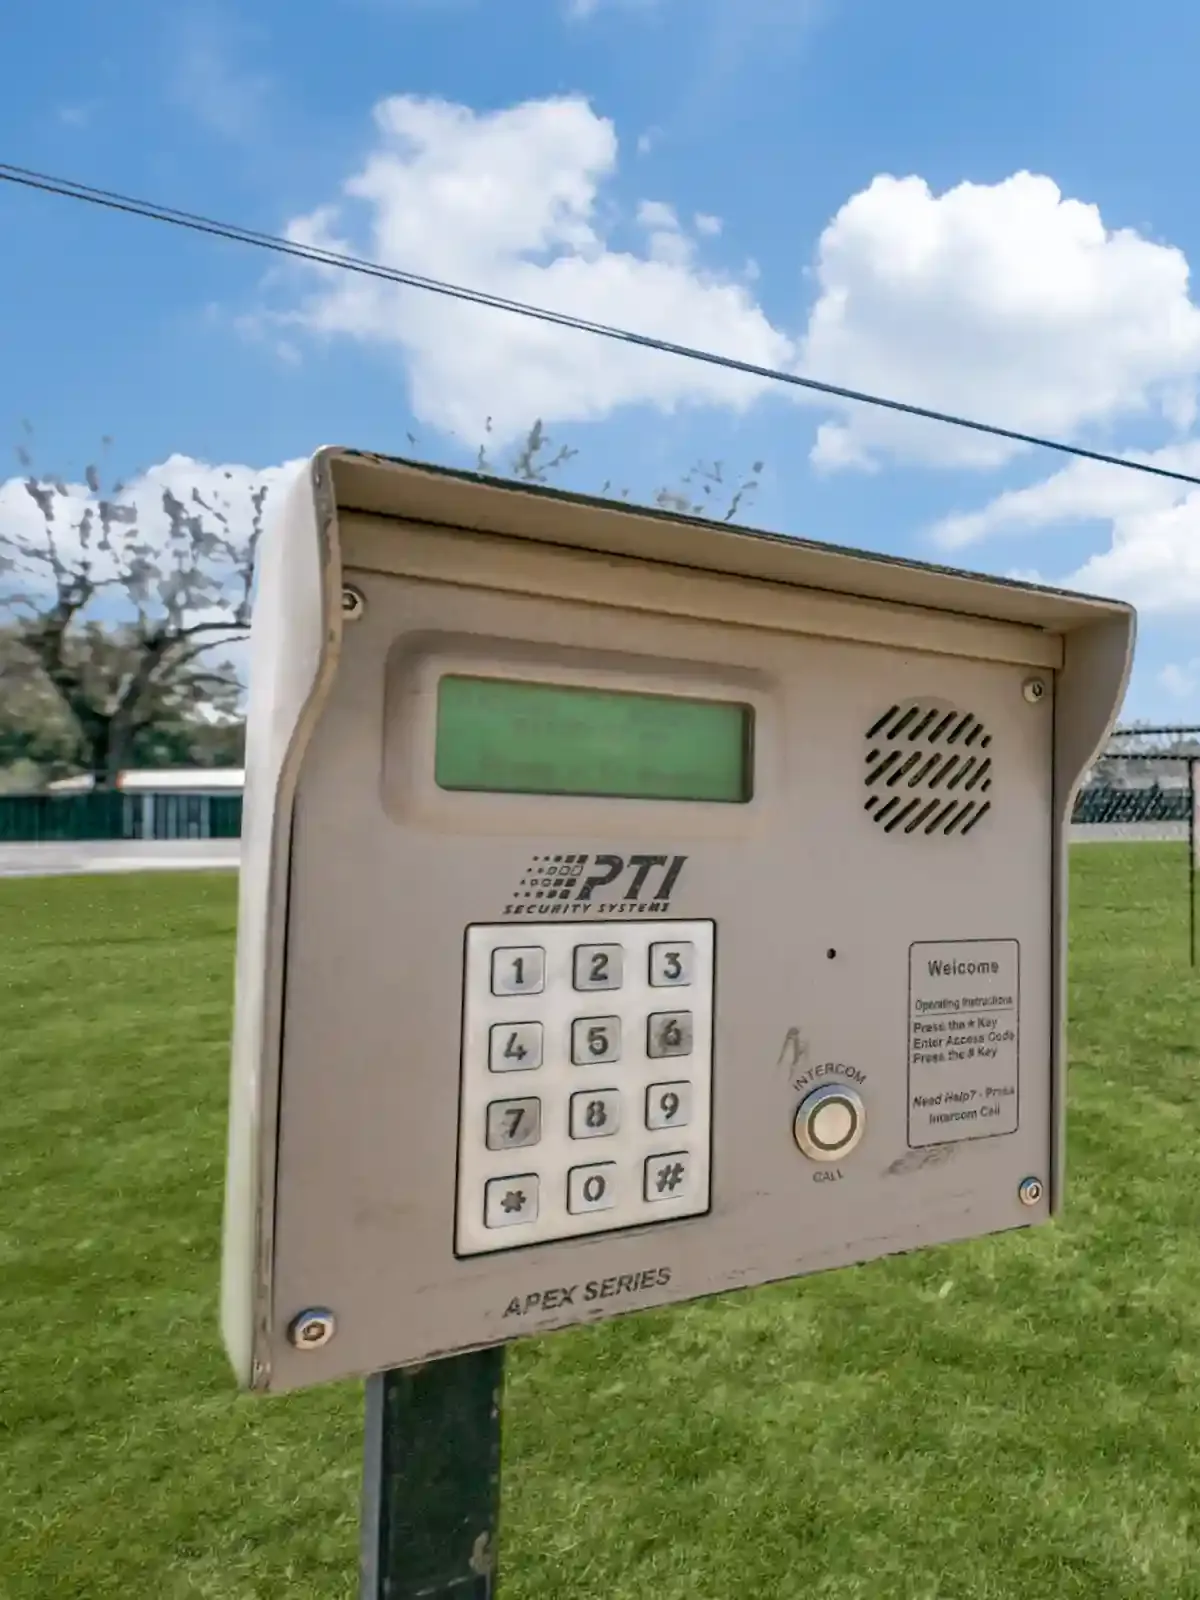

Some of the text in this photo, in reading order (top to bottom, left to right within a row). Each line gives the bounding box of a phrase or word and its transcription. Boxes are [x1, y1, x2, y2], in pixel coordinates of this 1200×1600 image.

[574, 854, 689, 900] PTI
[503, 902, 670, 915] SECURITY SYSTEMS
[512, 952, 682, 985] 1 2 3
[927, 959, 999, 976] Welcome
[504, 1017, 680, 1061] 4 5 6
[913, 1038, 942, 1049] Enter
[988, 1030, 1015, 1042] Code
[793, 1063, 867, 1091] INTERCOM
[505, 1092, 679, 1139] 7 8 9
[584, 1175, 605, 1201] 0
[813, 1169, 843, 1183] CALL
[502, 1267, 673, 1317] APEX SERIES
